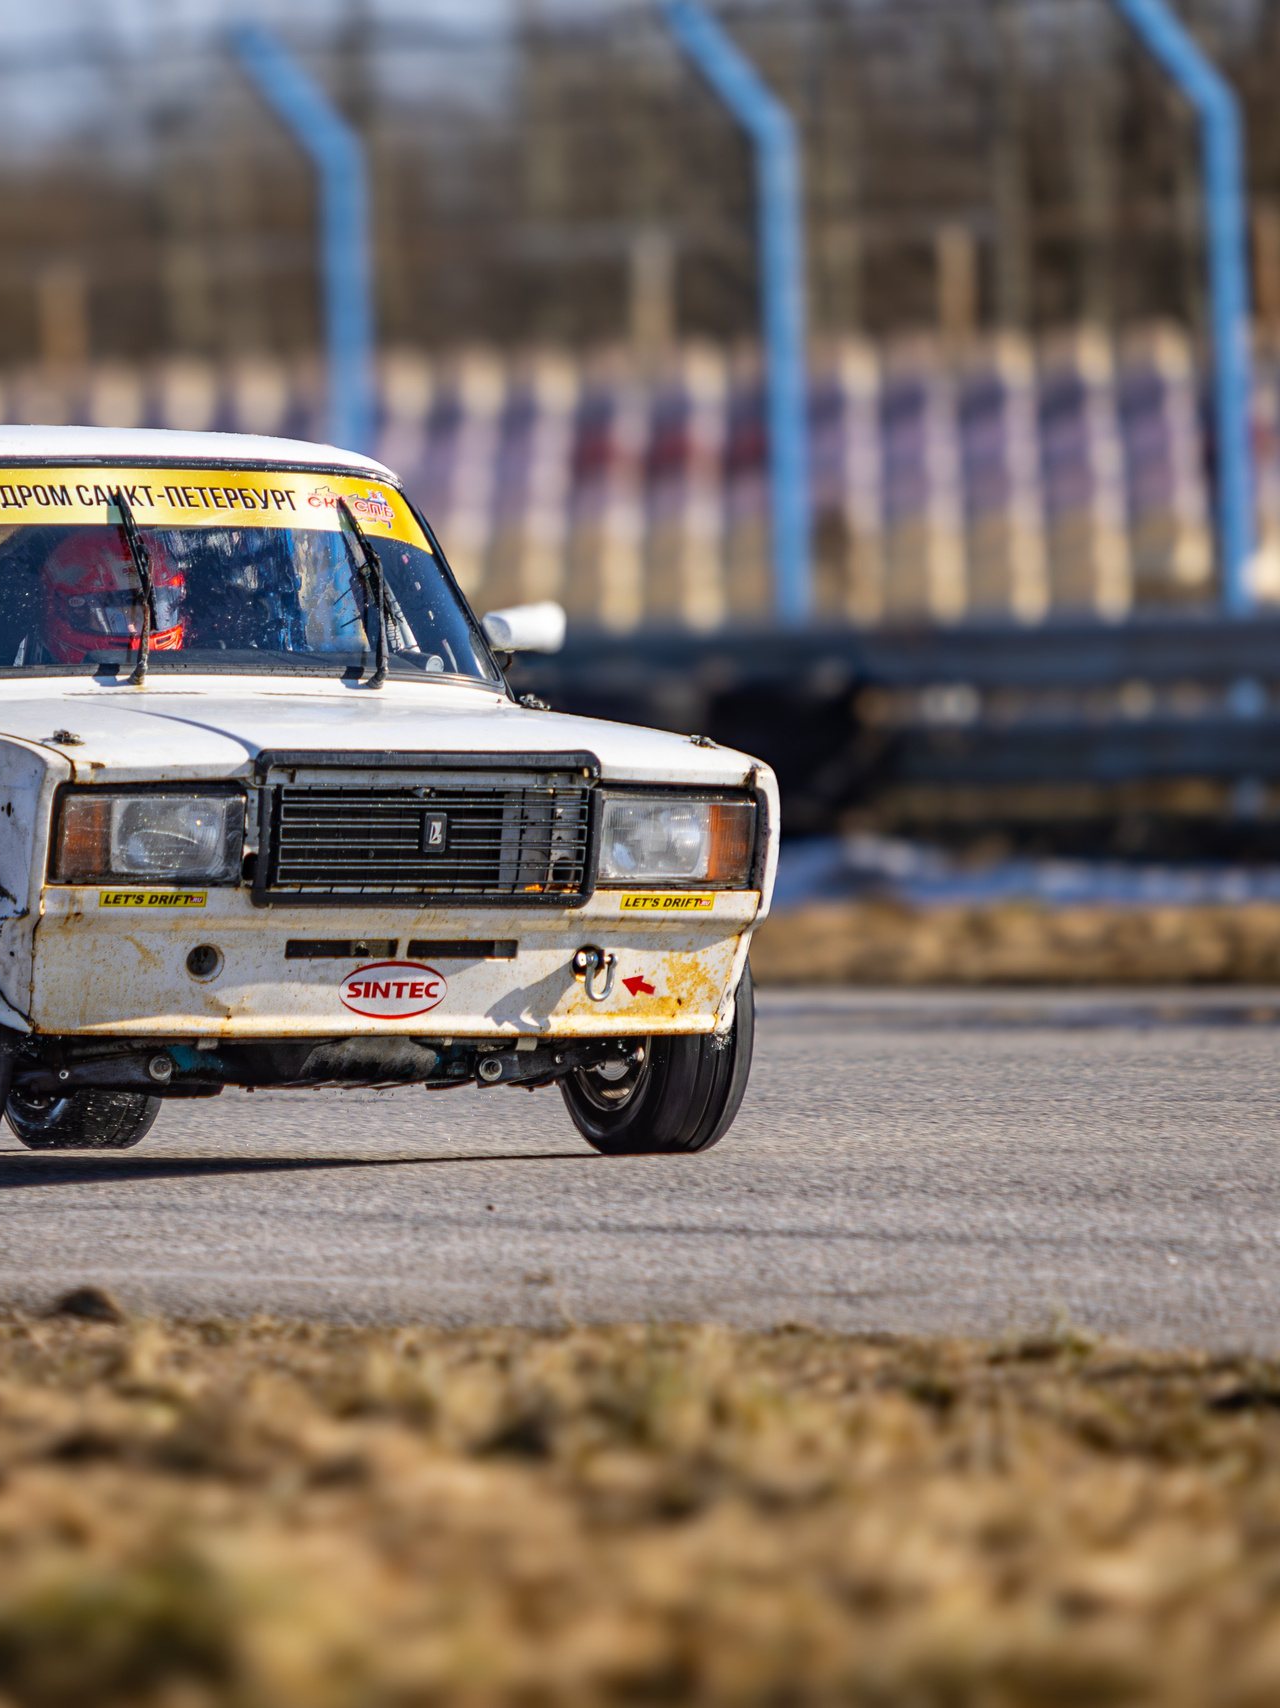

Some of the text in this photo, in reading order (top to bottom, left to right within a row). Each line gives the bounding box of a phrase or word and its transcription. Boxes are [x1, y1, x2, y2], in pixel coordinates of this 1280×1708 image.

[354, 500, 395, 519] СПБ
[103, 893, 145, 905] LET'S
[624, 897, 661, 908] LET'S
[346, 981, 440, 999] SINTEC
